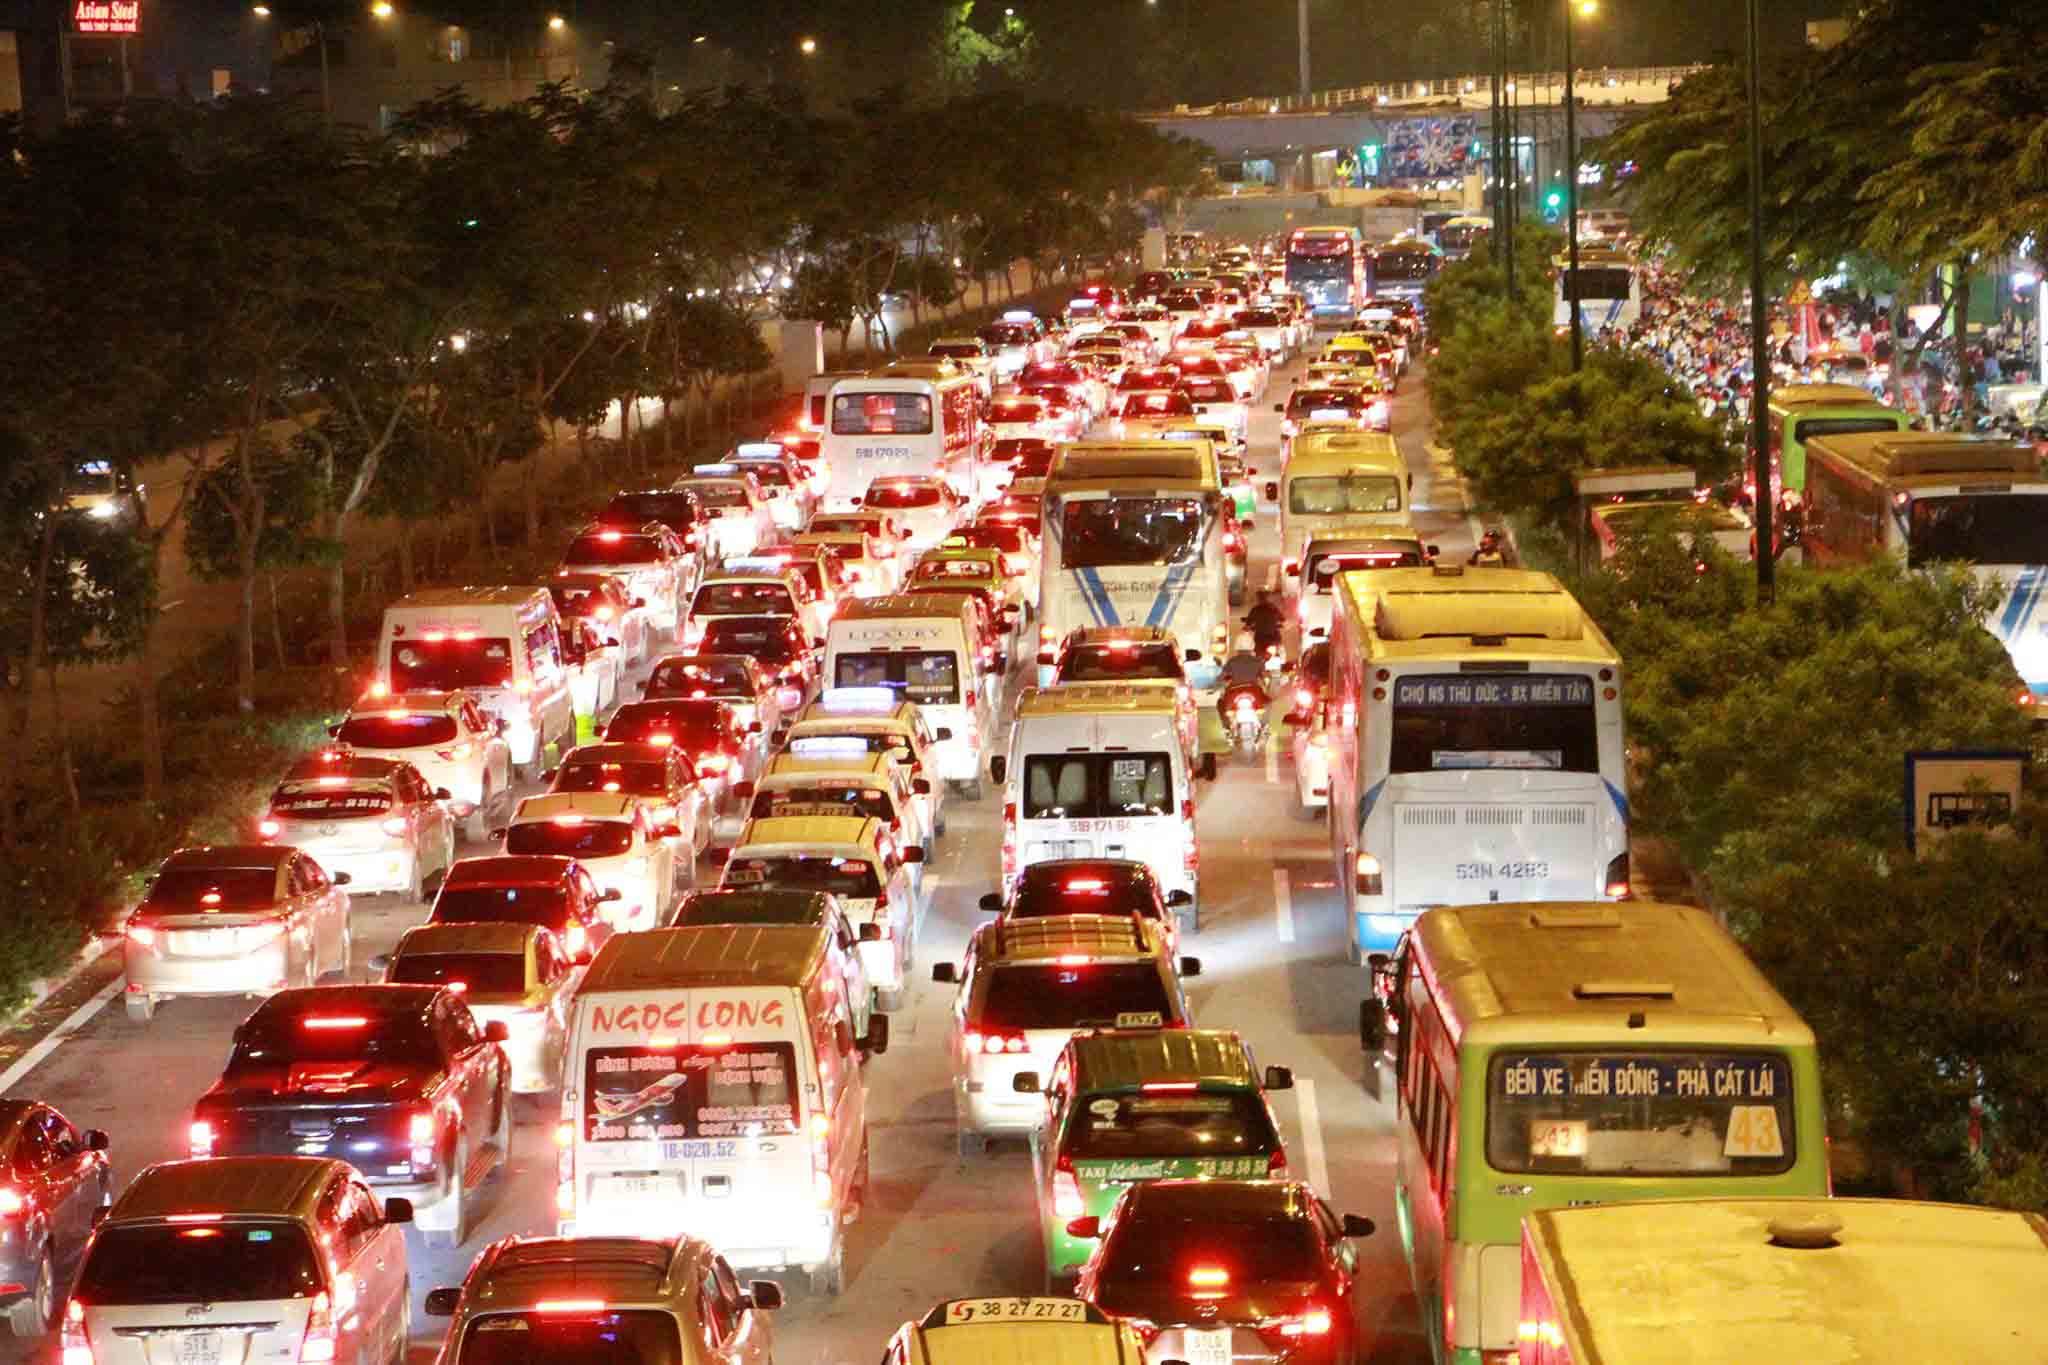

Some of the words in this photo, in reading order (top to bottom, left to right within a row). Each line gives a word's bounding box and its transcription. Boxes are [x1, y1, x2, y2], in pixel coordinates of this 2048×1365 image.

[75, 1, 109, 19] Asian
[111, 1, 138, 19] Steel
[1448, 681, 1471, 702] THỦ
[1566, 681, 1588, 702] TÂY
[1456, 863, 1493, 880] 53N
[697, 999, 784, 1028] LONG
[1505, 1057, 1537, 1095] BẾN
[1542, 1068, 1564, 1095] XE
[1615, 1062, 1658, 1096] ĐÔNG
[1677, 1062, 1709, 1096] PHÀ
[1714, 1062, 1744, 1096] CÁT
[1750, 1062, 1774, 1096] LÁI
[1732, 1108, 1778, 1153] 43
[1078, 1167, 1107, 1179] TAXI
[982, 1302, 1001, 1316] 38
[1009, 1302, 1029, 1316] 27
[1035, 1303, 1055, 1317] 27
[1061, 1303, 1081, 1317] 27
